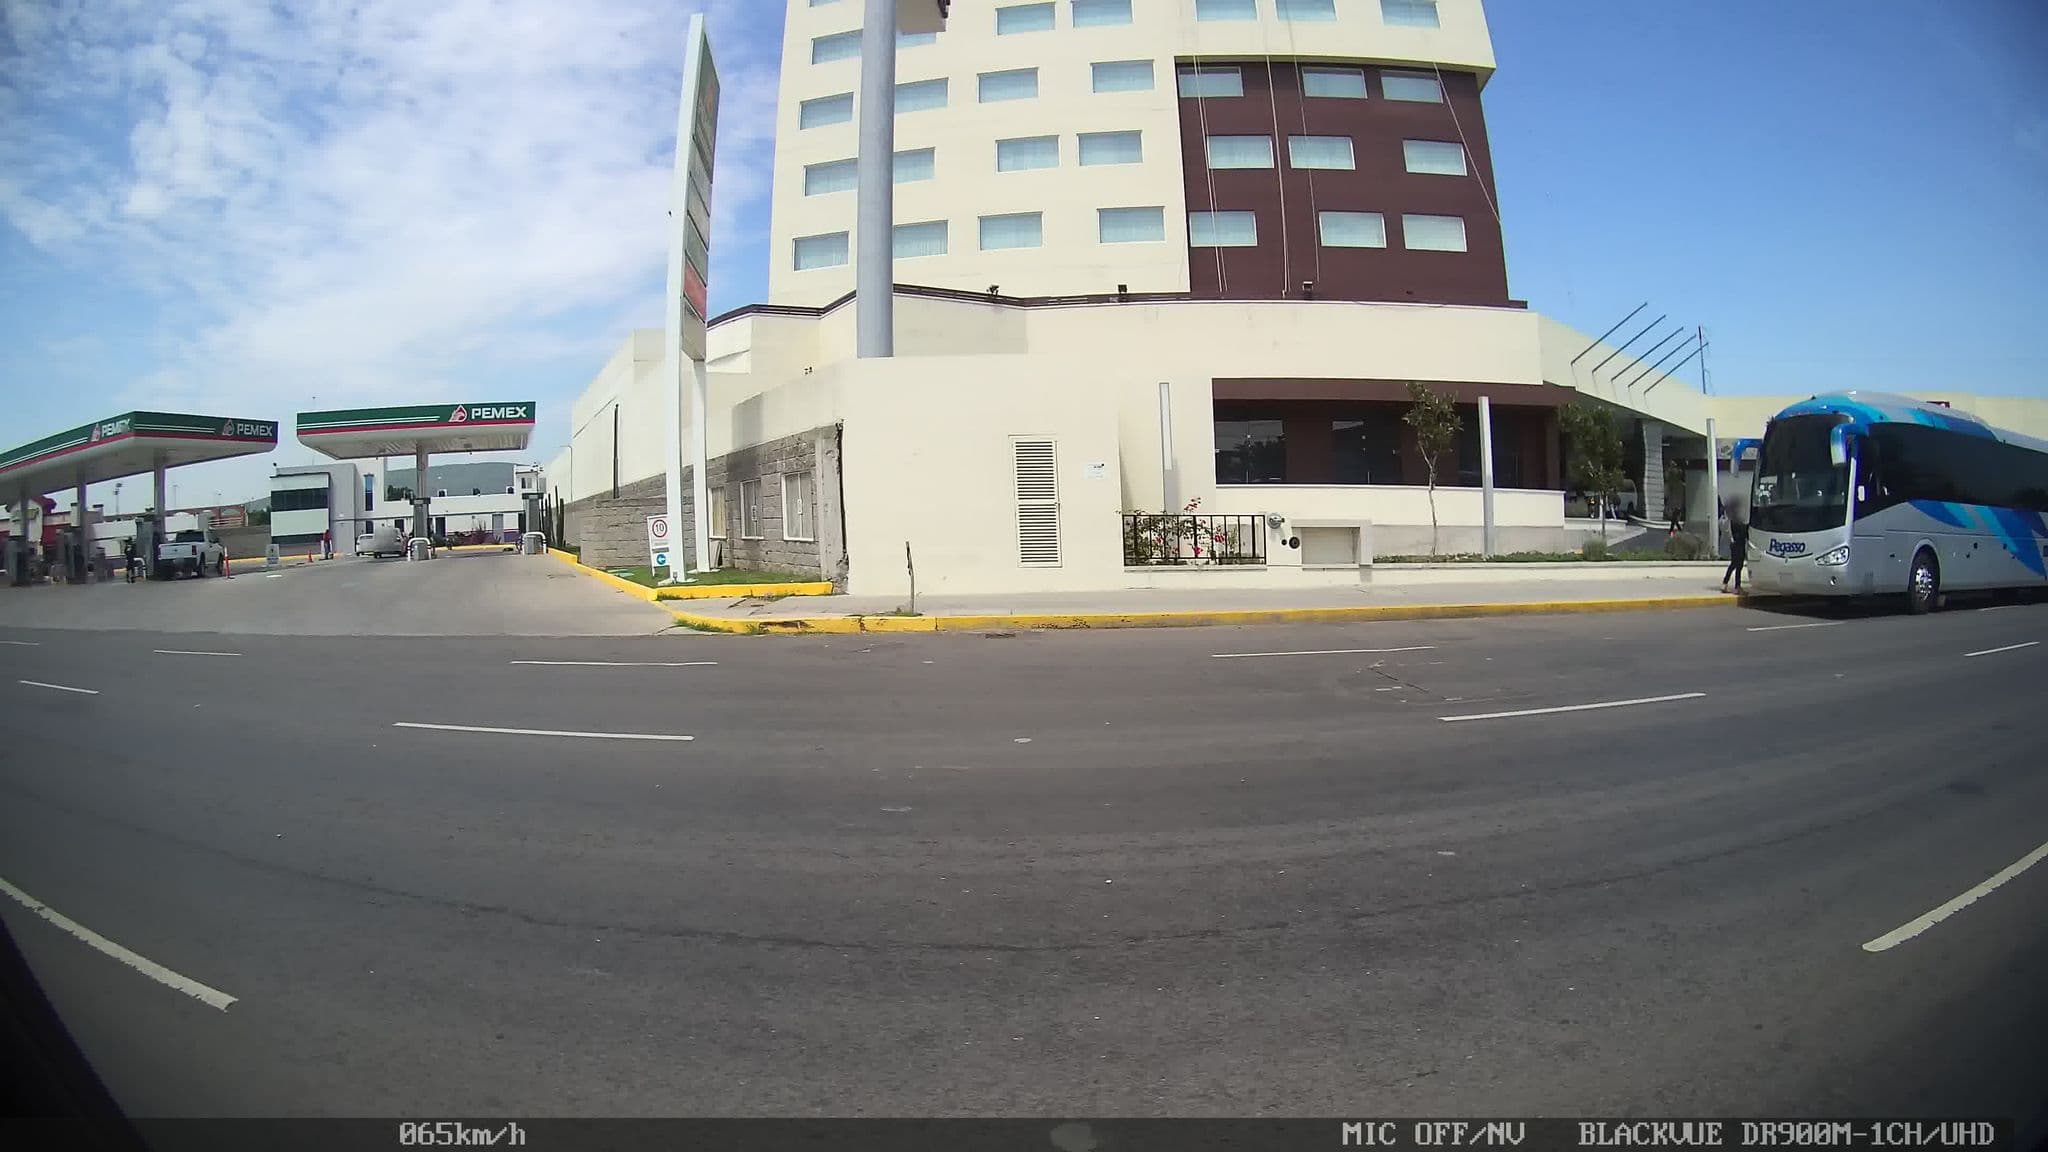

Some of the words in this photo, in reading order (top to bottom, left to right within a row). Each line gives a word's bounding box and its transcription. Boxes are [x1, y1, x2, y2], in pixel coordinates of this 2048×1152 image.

[470, 406, 527, 420] PEMEX
[236, 422, 273, 437] PEMEX
[655, 523, 665, 533] 10
[1769, 538, 1806, 556] Pegasso
